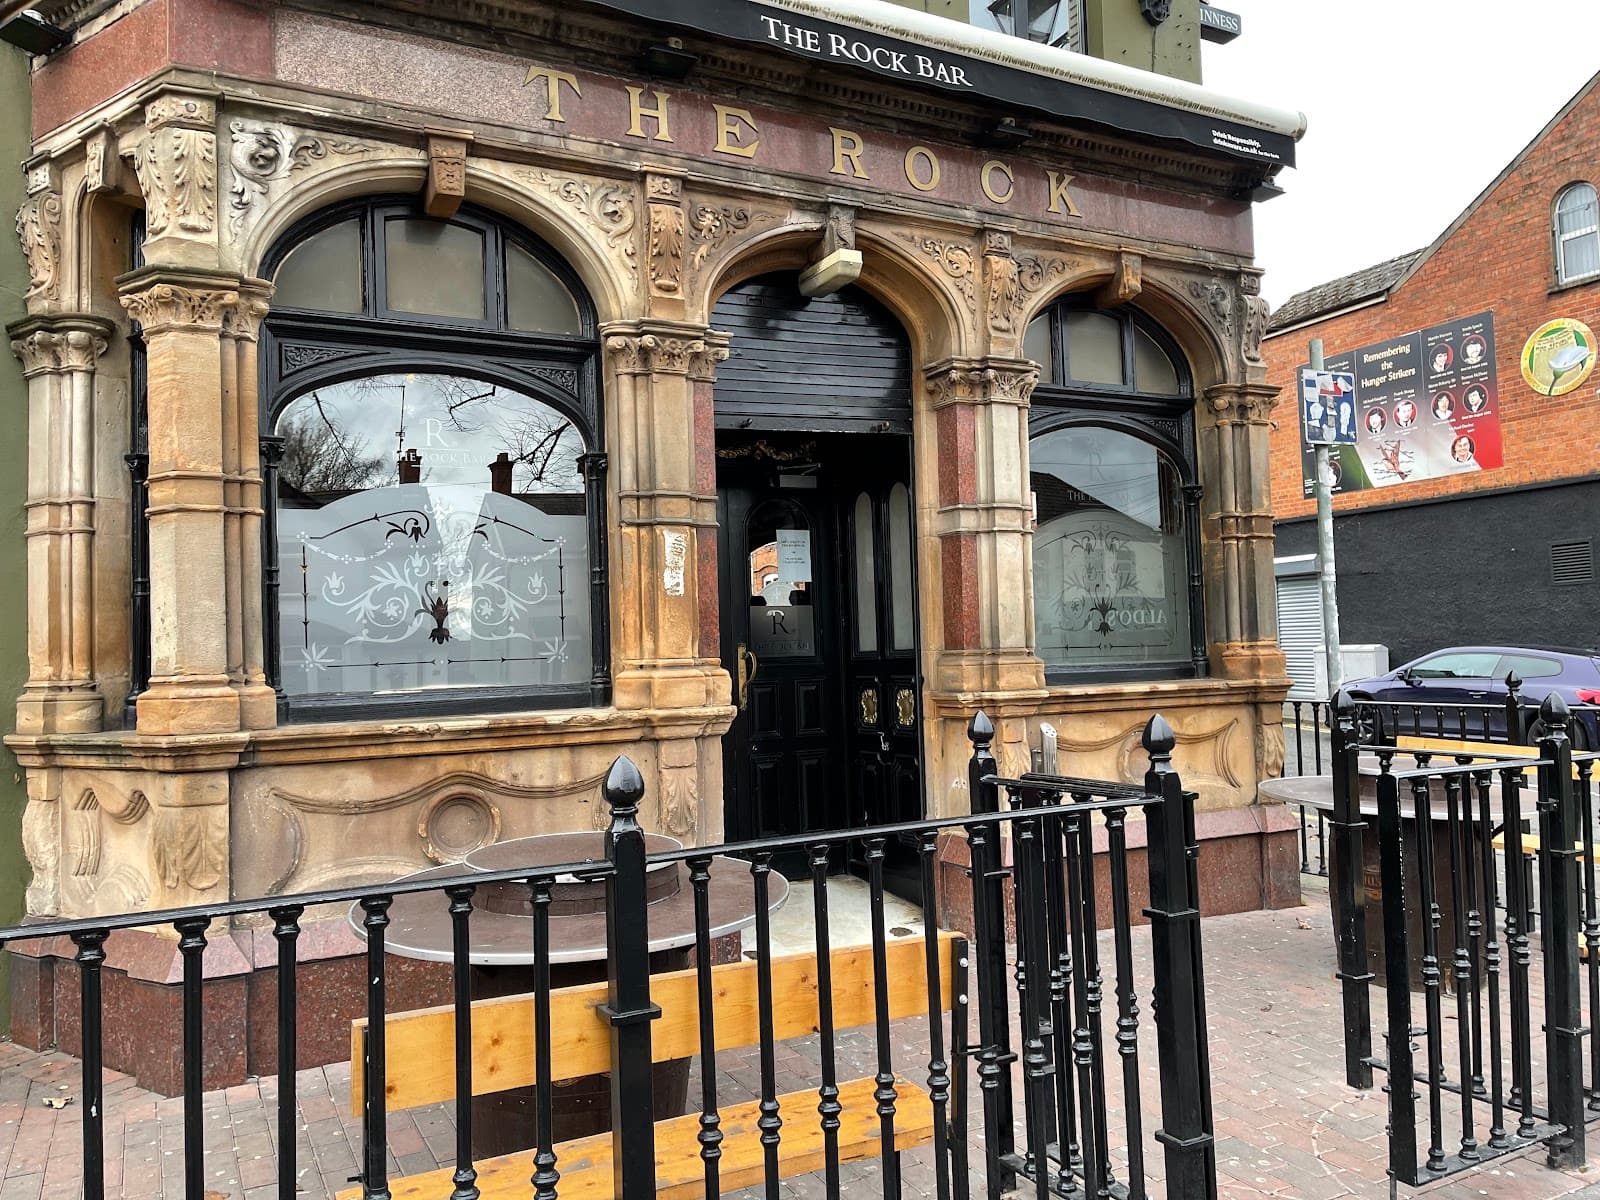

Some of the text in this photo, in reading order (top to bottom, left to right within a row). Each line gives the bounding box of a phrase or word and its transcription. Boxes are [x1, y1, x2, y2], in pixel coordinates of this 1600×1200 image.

[1200, 8, 1239, 31] INNESS
[760, 15, 974, 87] THE ROCK BAR
[523, 65, 1081, 217] THE ROCK
[1363, 343, 1411, 364] Remembering
[1380, 360, 1393, 371] the
[1361, 375, 1388, 389] Hunger
[1387, 367, 1416, 381] Strikers
[424, 417, 449, 448] R
[766, 609, 791, 635] R
